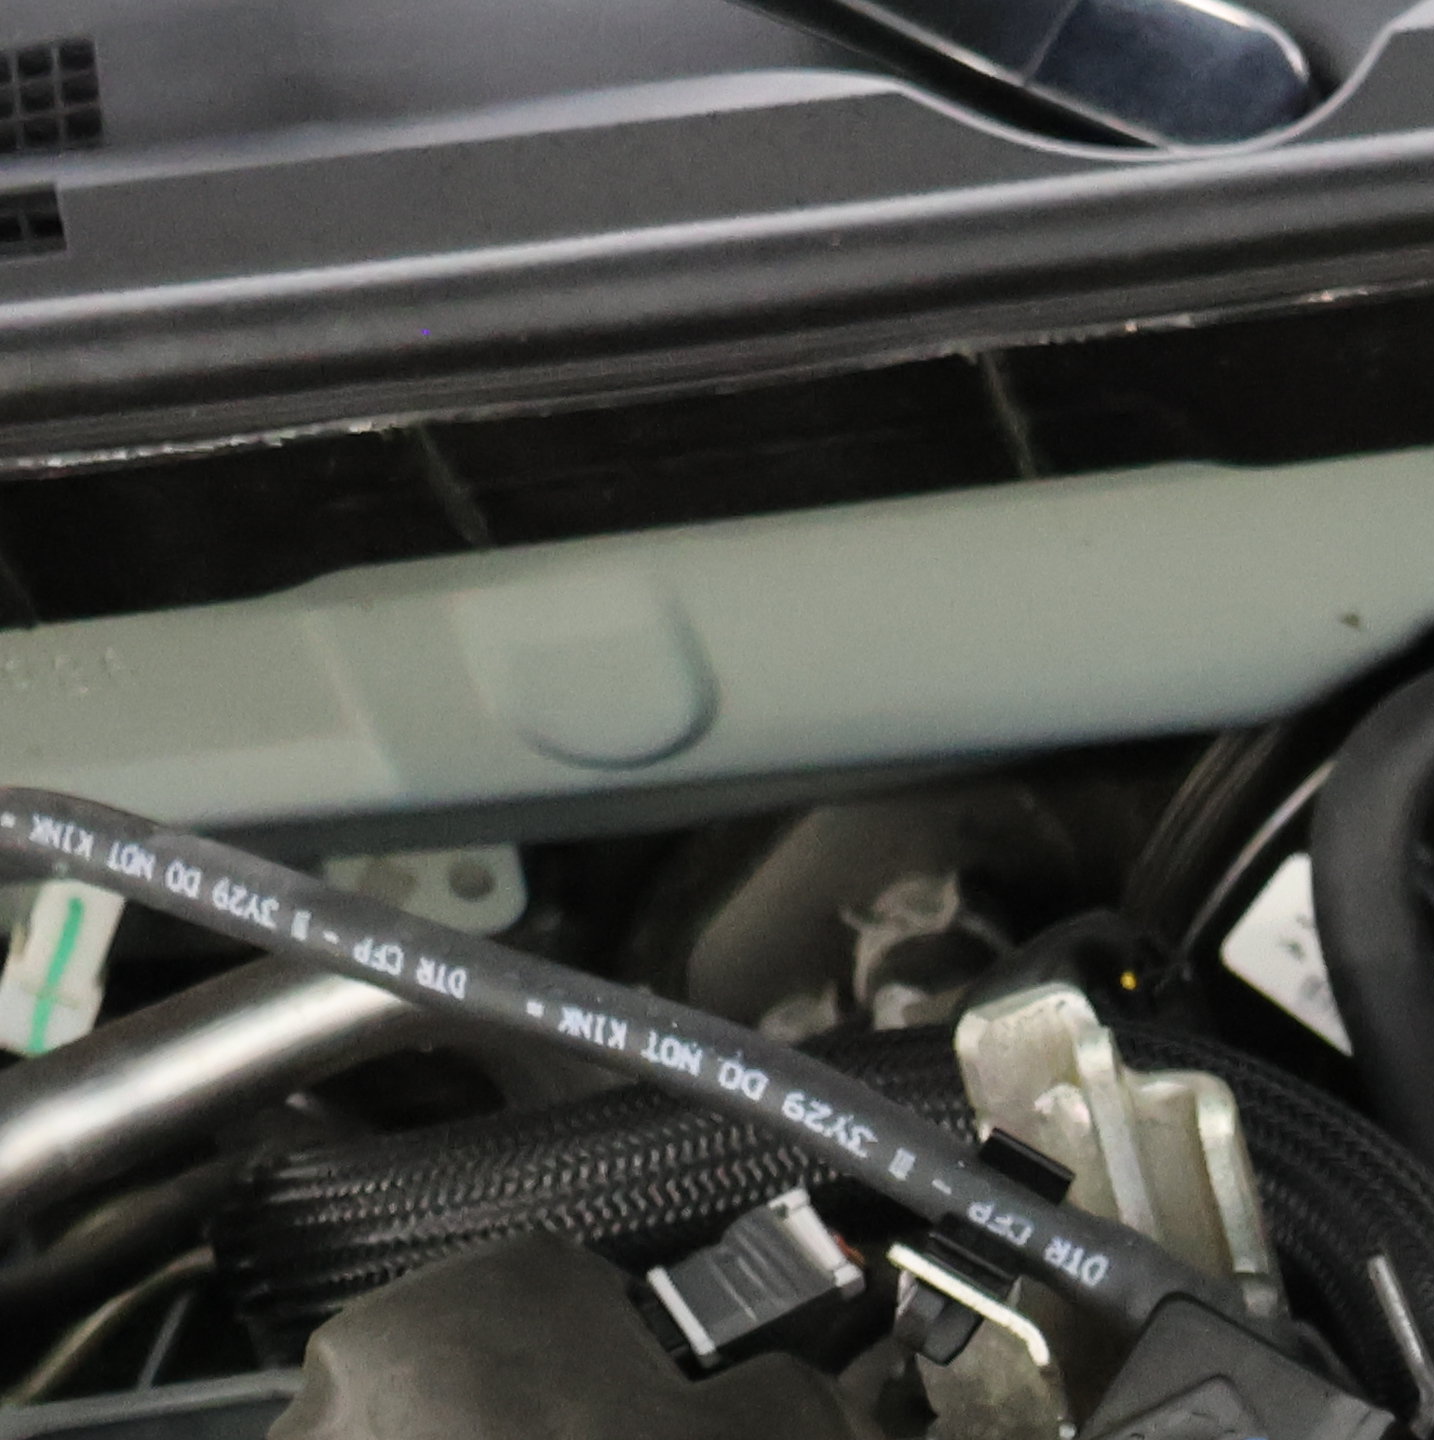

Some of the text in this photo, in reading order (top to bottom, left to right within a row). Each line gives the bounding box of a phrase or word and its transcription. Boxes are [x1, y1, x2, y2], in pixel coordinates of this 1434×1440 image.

[29, 811, 95, 862] KINK
[106, 840, 157, 881] NOT
[164, 859, 203, 899] DO
[415, 955, 468, 1000] DTR
[556, 1005, 628, 1051] KINK
[639, 1030, 703, 1078] NOT
[717, 1060, 770, 1102] DO
[780, 1091, 879, 1160] 3Y29
[967, 1200, 1036, 1247] CFP
[1043, 1235, 1110, 1288] DTR
